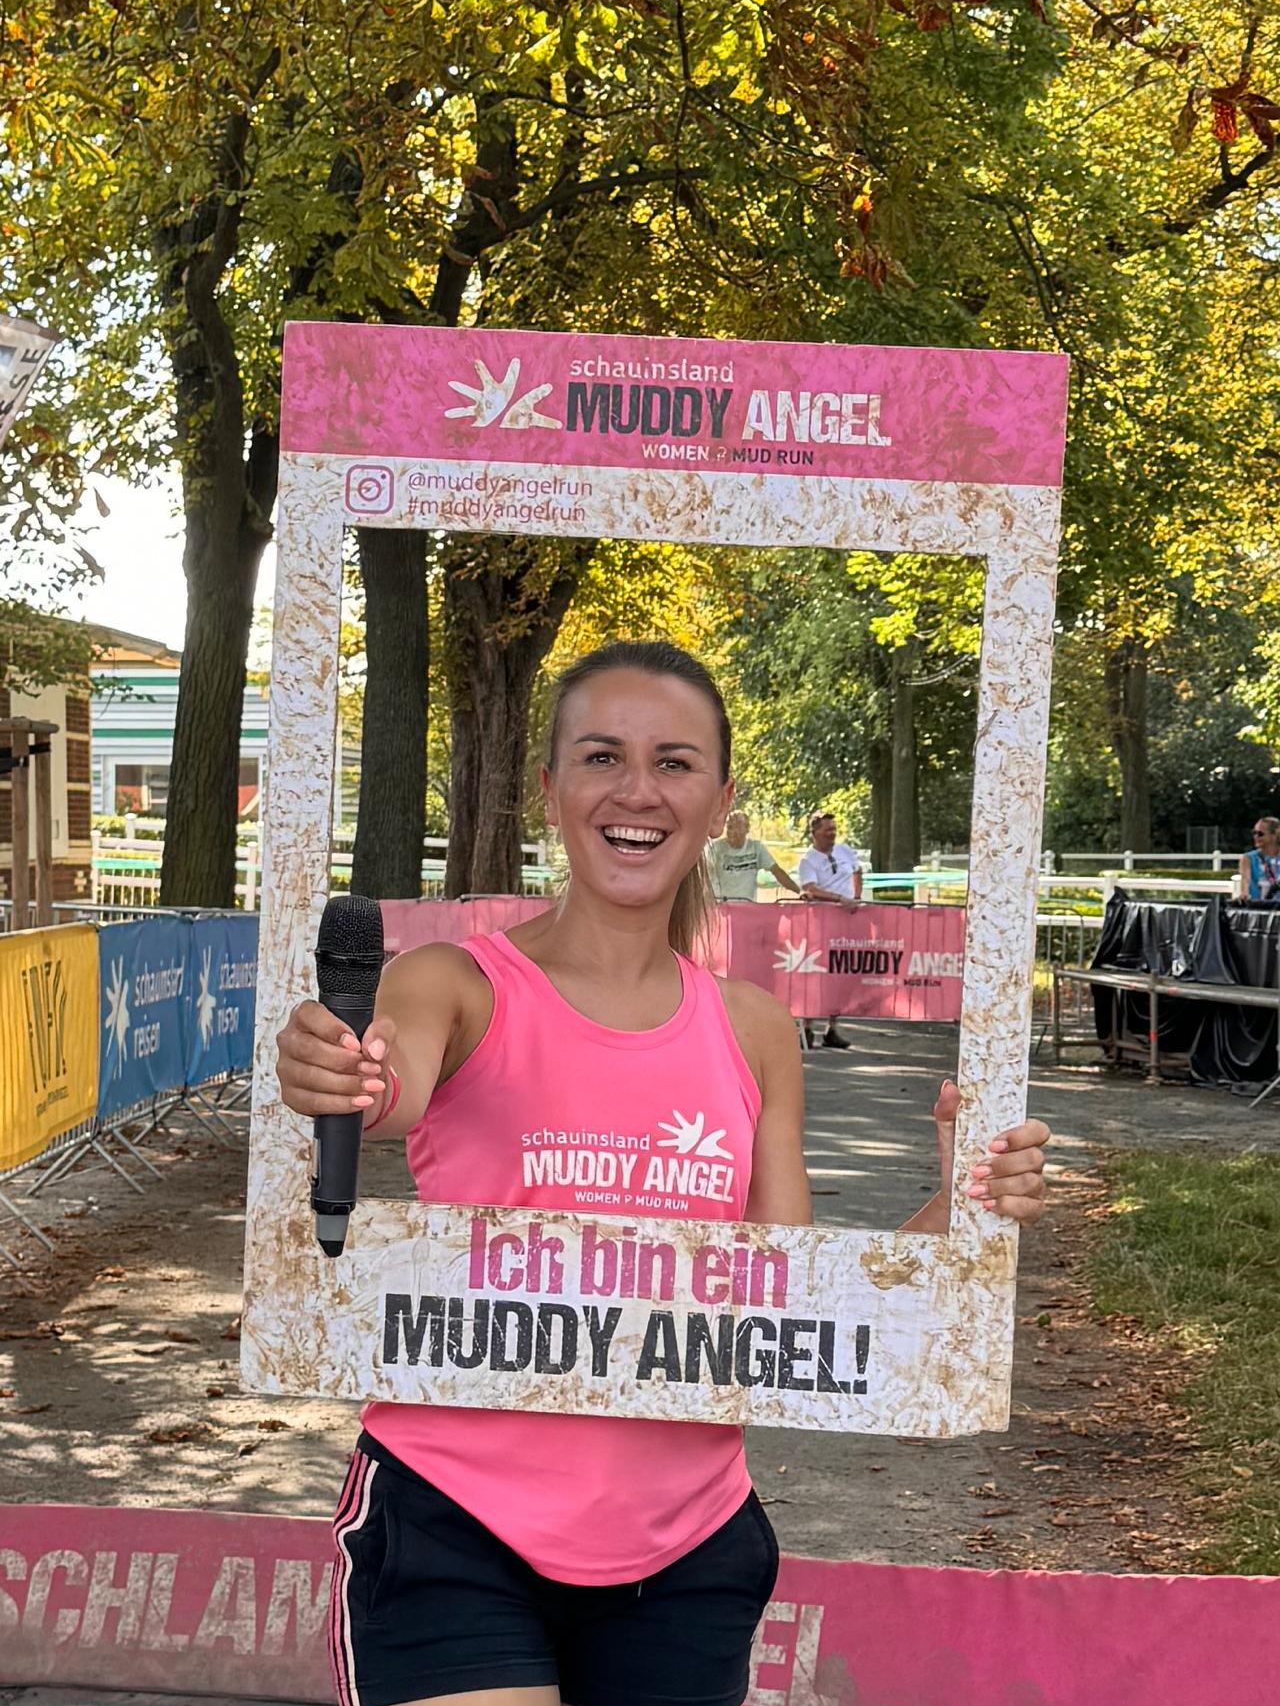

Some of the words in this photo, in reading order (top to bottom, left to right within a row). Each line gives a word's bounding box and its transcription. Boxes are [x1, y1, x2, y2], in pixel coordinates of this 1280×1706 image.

[570, 355, 733, 382] schauinsland
[566, 382, 733, 438] MUDDY
[741, 390, 891, 446] ANGEL
[642, 444, 709, 461] WOMEN
[733, 448, 770, 464] MUD
[776, 450, 814, 465] RUN
[408, 470, 592, 499] @muddyangelrun
[408, 496, 585, 523] #muddyangelrun
[829, 950, 904, 975] MUDDY
[907, 952, 962, 977] ANGE
[521, 1127, 650, 1150] schauinsland
[522, 1149, 638, 1189] MUDDY
[643, 1156, 735, 1204] ANGEL
[575, 1191, 620, 1204] WOMEN
[635, 1195, 661, 1208] MUD
[664, 1198, 688, 1211] RUN
[468, 1217, 565, 1294] Ich
[580, 1223, 677, 1302] bin
[690, 1233, 789, 1309] ein
[382, 1293, 623, 1377] MUDDY
[636, 1308, 871, 1395] ANGEL!
